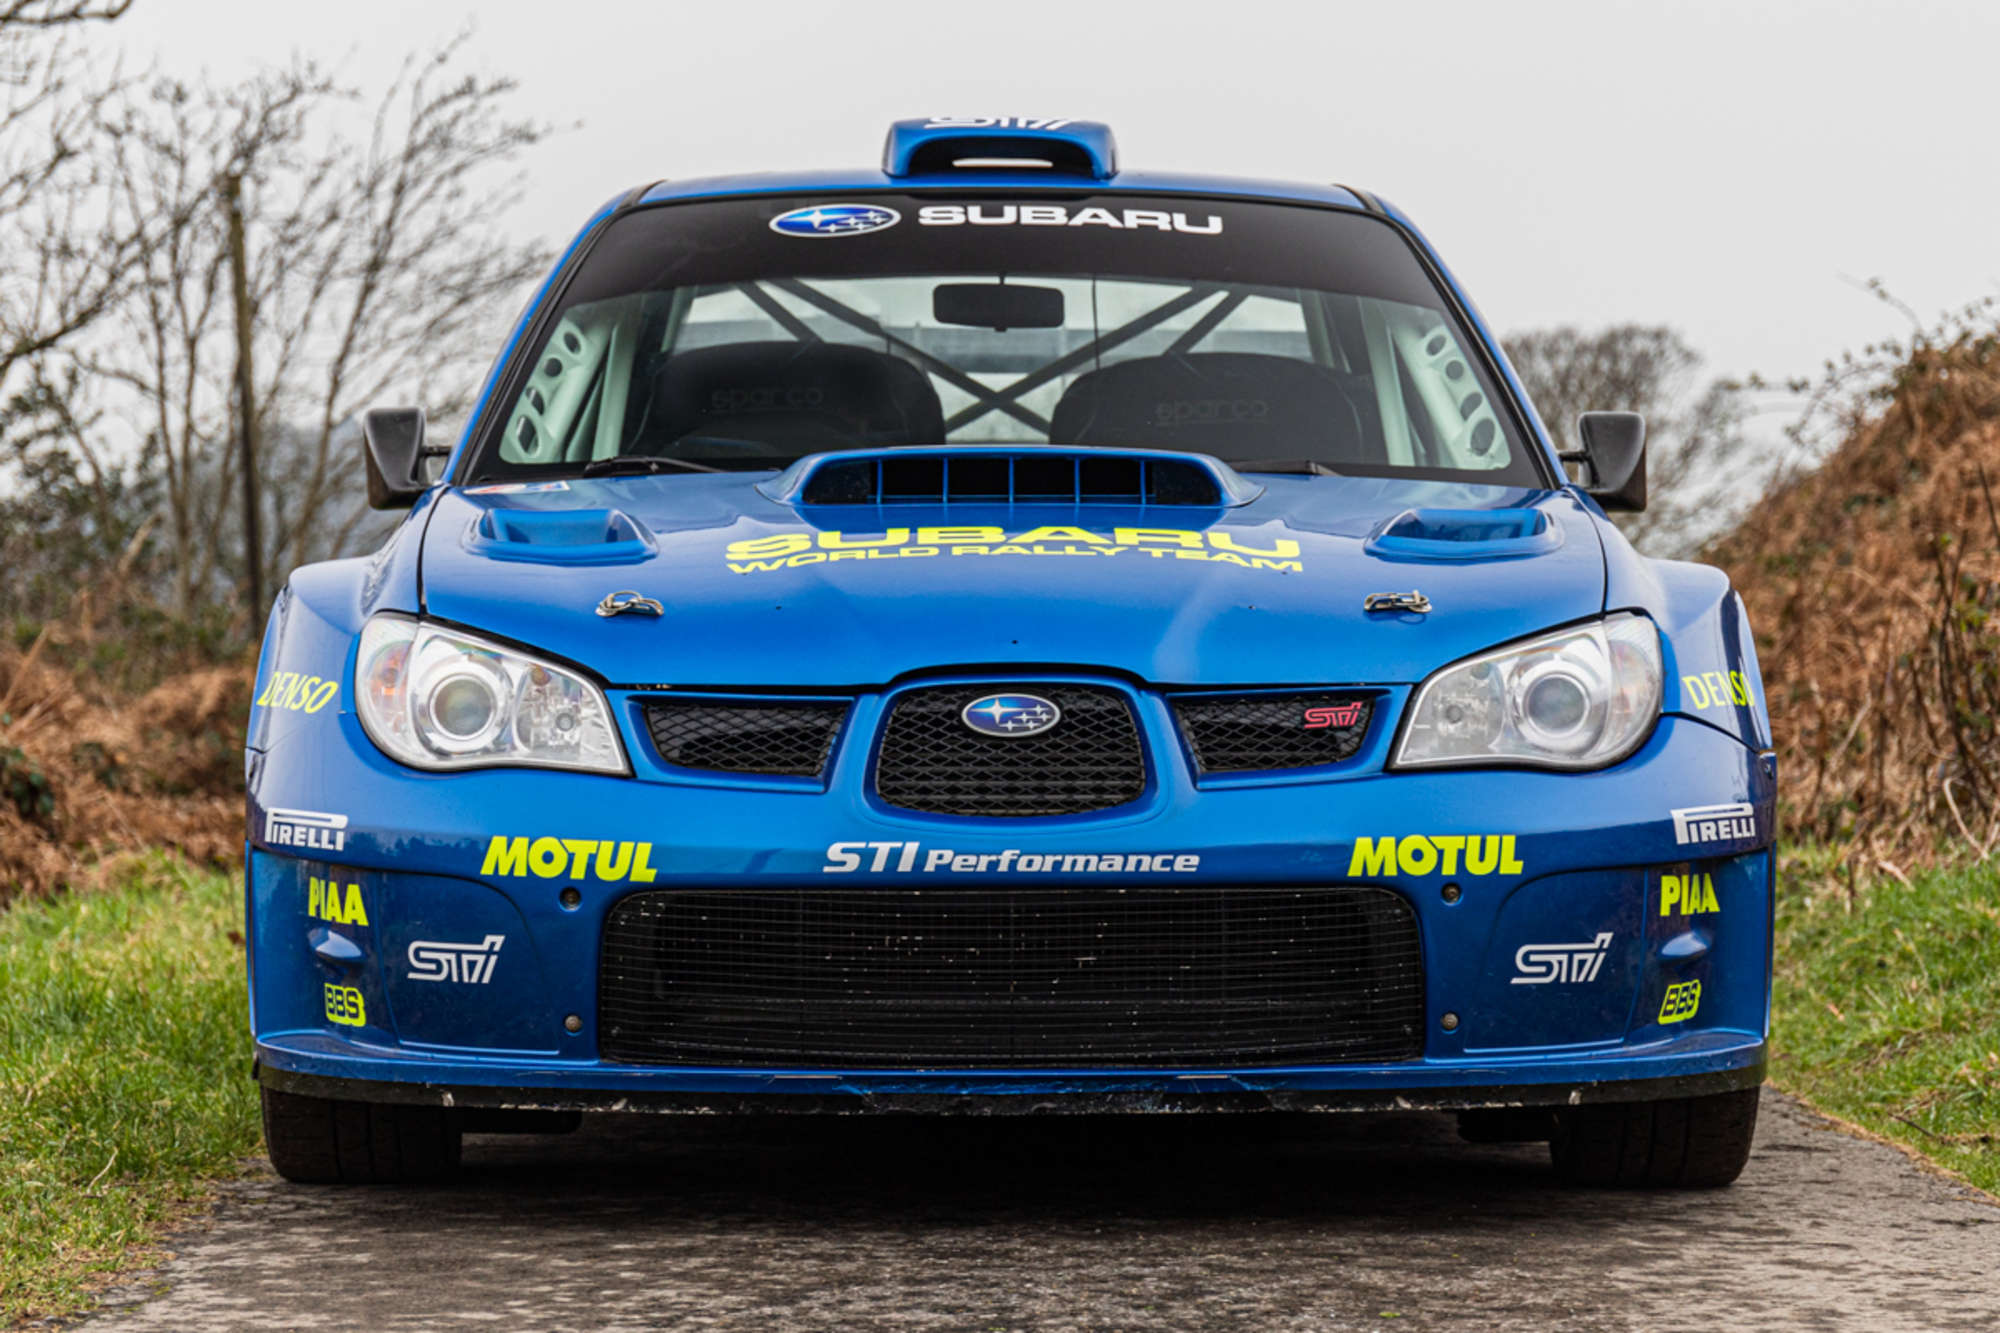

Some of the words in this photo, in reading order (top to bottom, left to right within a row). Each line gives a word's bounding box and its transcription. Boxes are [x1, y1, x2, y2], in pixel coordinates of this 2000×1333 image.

[918, 205, 1223, 235] SUBARU
[725, 526, 1300, 560] SUBARU
[726, 546, 940, 574] WORLD
[952, 545, 1128, 556] RALLY
[1138, 547, 1303, 572] TEAM
[256, 671, 339, 714] DENSO
[1681, 669, 1755, 710] DENSO
[264, 807, 348, 852] PIRELLI
[1670, 802, 1755, 845] PIRELLI
[480, 835, 658, 883] MOTUL
[823, 841, 919, 873] STI
[923, 849, 1200, 873] Performance
[1347, 834, 1524, 877] MOTUL
[308, 876, 369, 927] PIAA
[1659, 872, 1720, 916] PIAA
[325, 983, 366, 1026] BBS
[1658, 979, 1701, 1024] BBS
